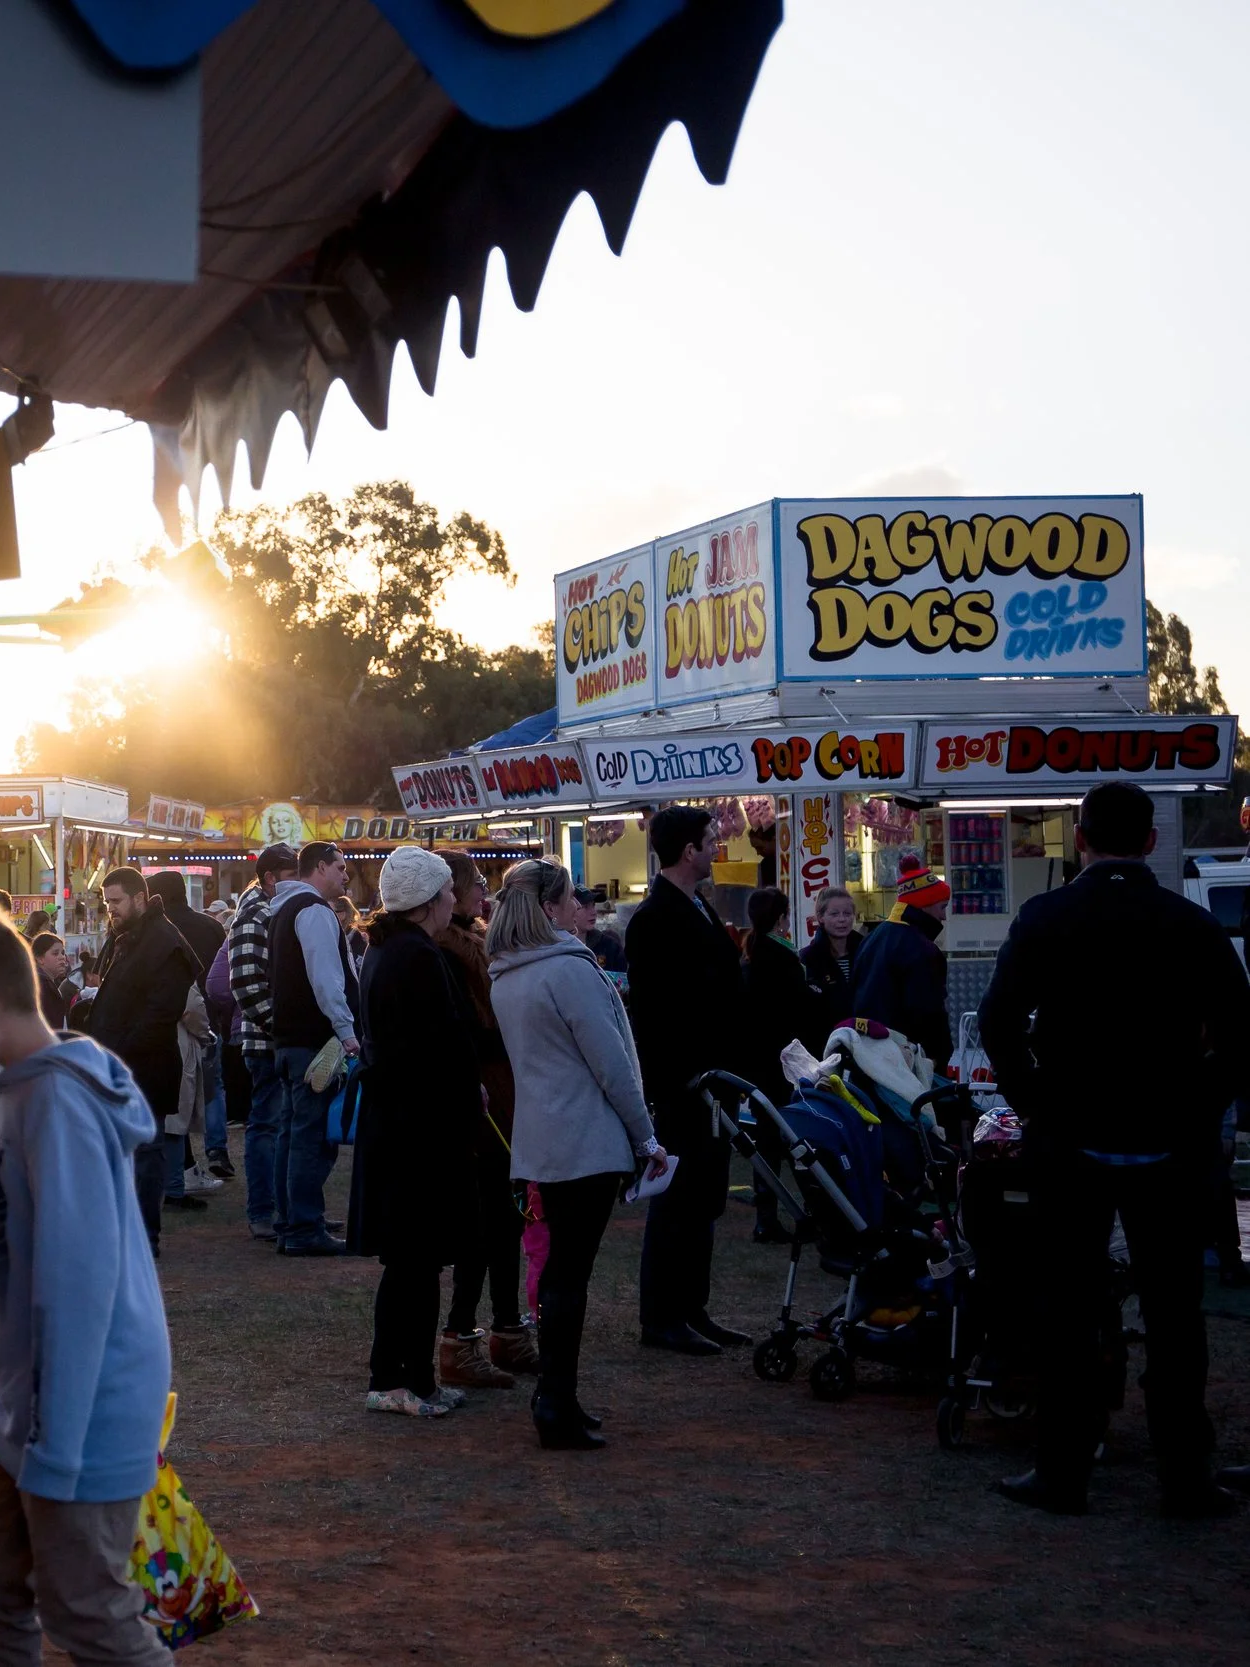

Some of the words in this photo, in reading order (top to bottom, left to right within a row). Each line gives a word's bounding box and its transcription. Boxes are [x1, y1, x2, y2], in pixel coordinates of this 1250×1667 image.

[704, 521, 758, 589] JAM
[797, 511, 1130, 587] DAGWOOD
[568, 573, 598, 608] HOT
[1004, 581, 1108, 629] COLD
[665, 581, 766, 679] DONUTS
[807, 586, 998, 662] DOGS
[576, 663, 620, 706] DAGWOOD
[622, 651, 647, 691] DOGS
[751, 736, 811, 783] POP
[814, 731, 906, 780] CORN
[935, 731, 1007, 773] HOT
[1005, 724, 1221, 774] DONUTS
[412, 764, 479, 810] DONUTS
[803, 797, 829, 856] HOT
